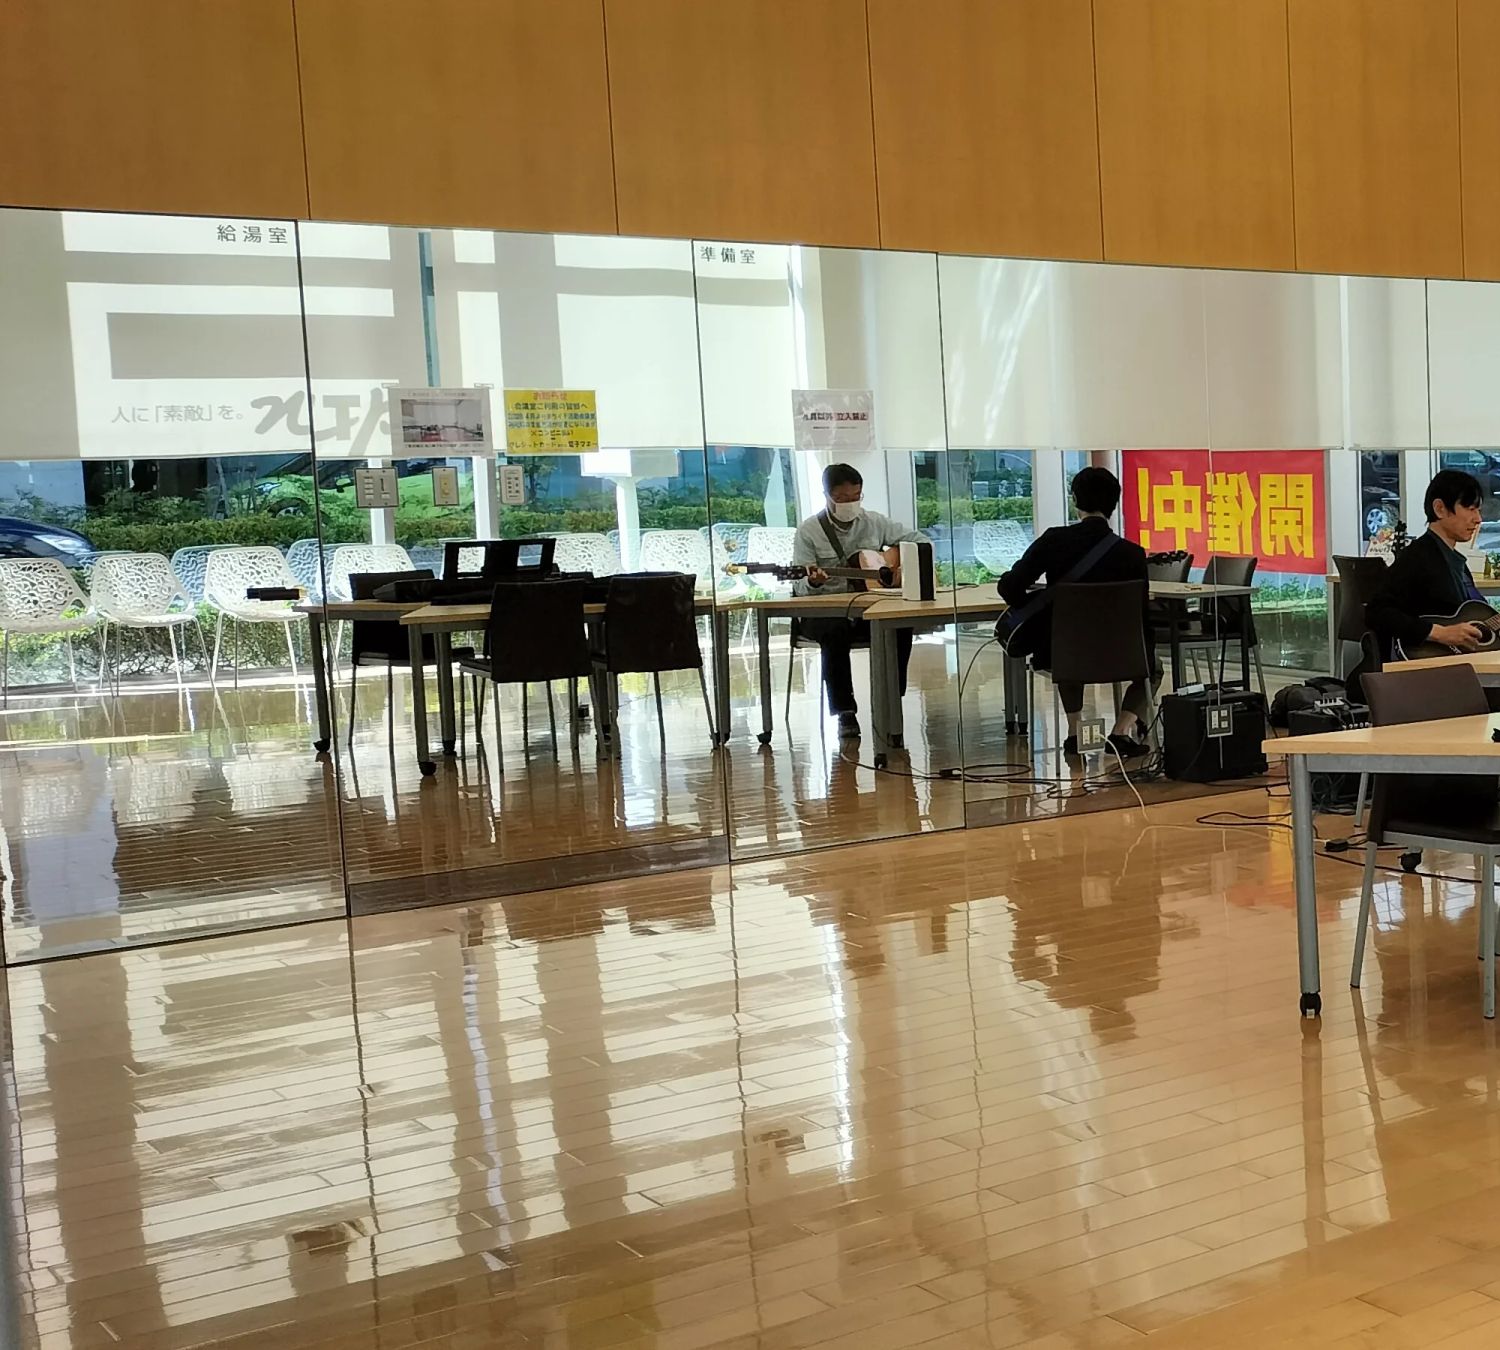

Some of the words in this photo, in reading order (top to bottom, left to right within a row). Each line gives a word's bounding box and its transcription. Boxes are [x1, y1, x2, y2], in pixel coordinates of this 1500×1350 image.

[216, 224, 288, 244] 給湯室
[699, 246, 756, 264] 準備室
[111, 404, 244, 423] 人に「素敵」を。
